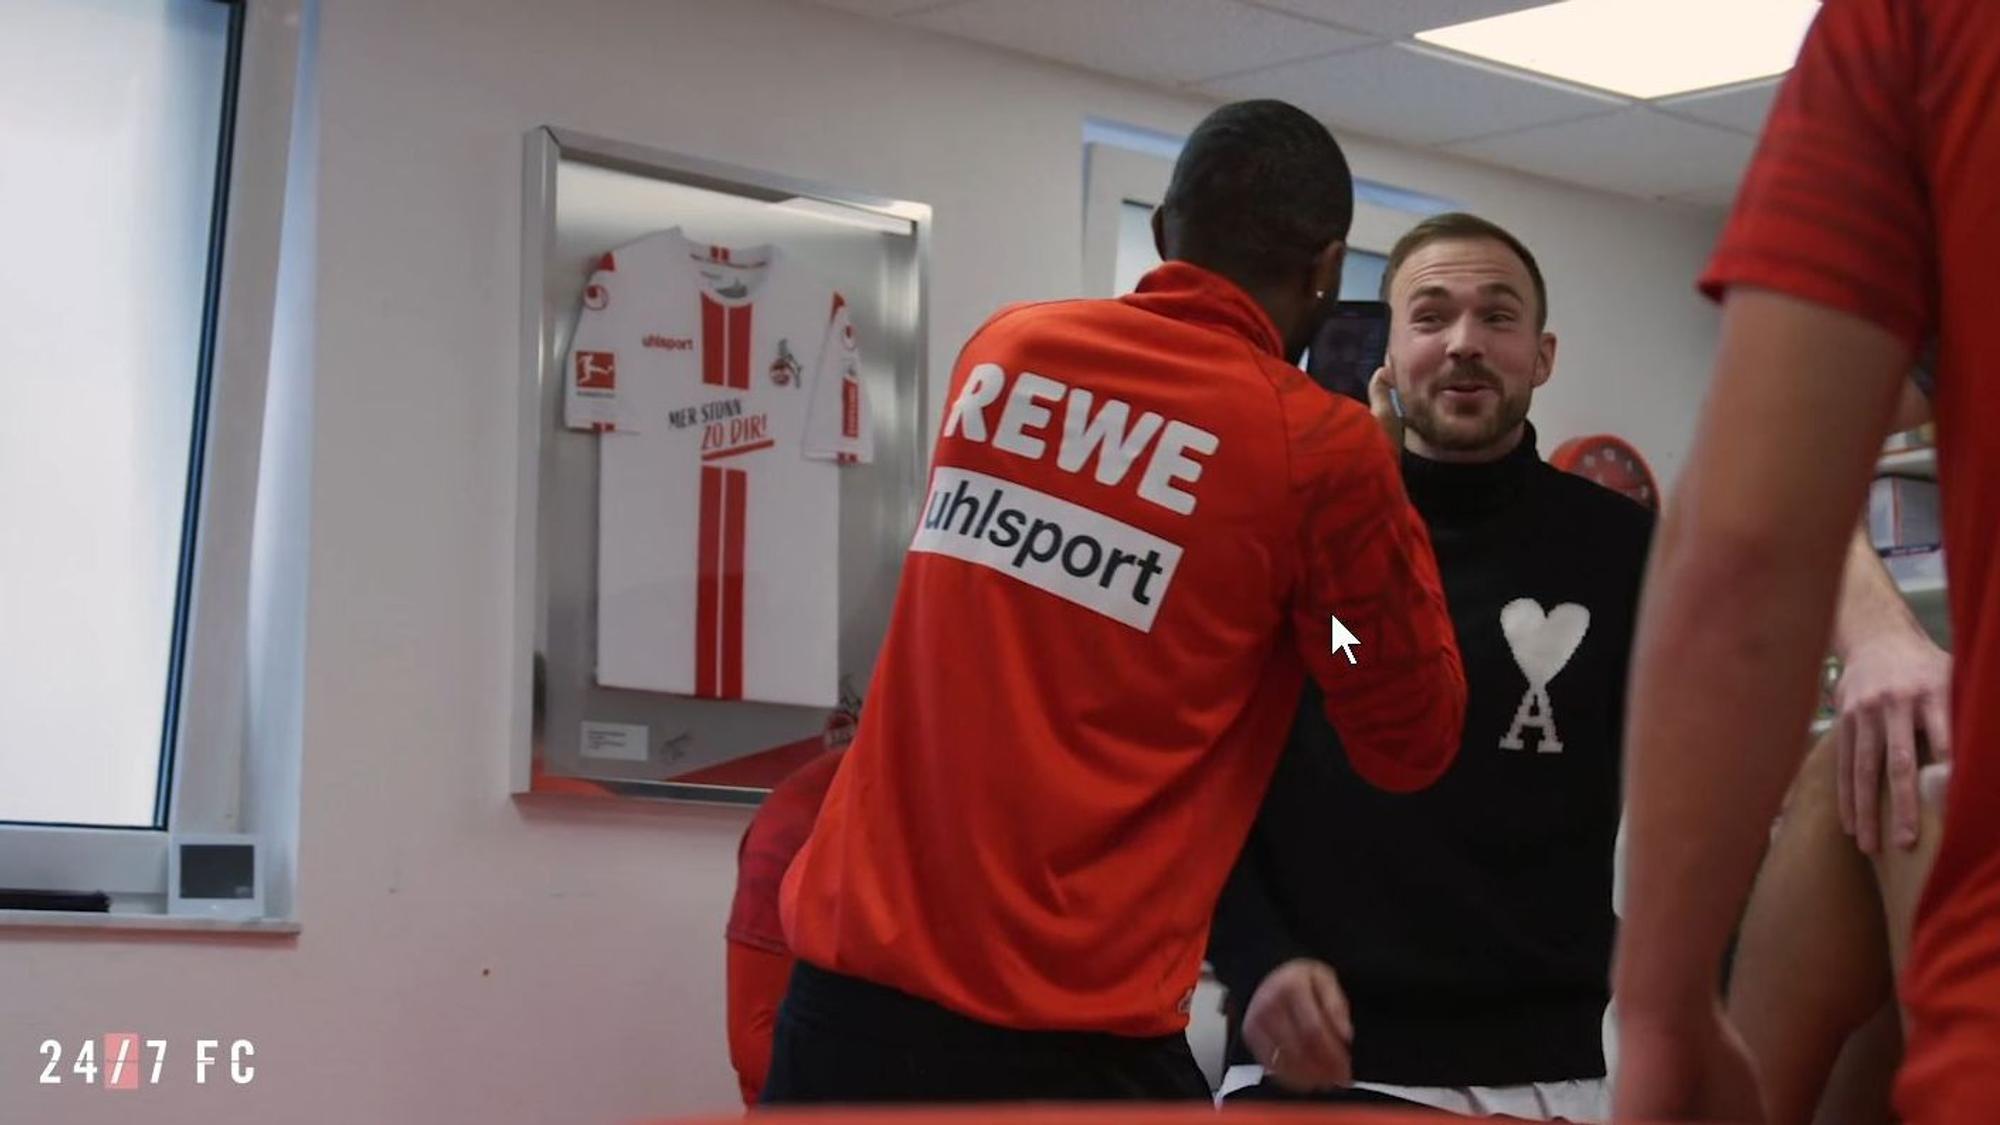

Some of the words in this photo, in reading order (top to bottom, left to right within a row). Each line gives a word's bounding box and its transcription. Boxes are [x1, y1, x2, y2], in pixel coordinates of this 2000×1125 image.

[642, 335, 693, 350] uhlsport
[669, 406, 697, 428] MER
[701, 422, 724, 449] ZO
[731, 413, 767, 445] DIR!
[944, 363, 1219, 516] REWE
[925, 480, 1163, 606] uhlsport
[1498, 684, 1564, 753] A
